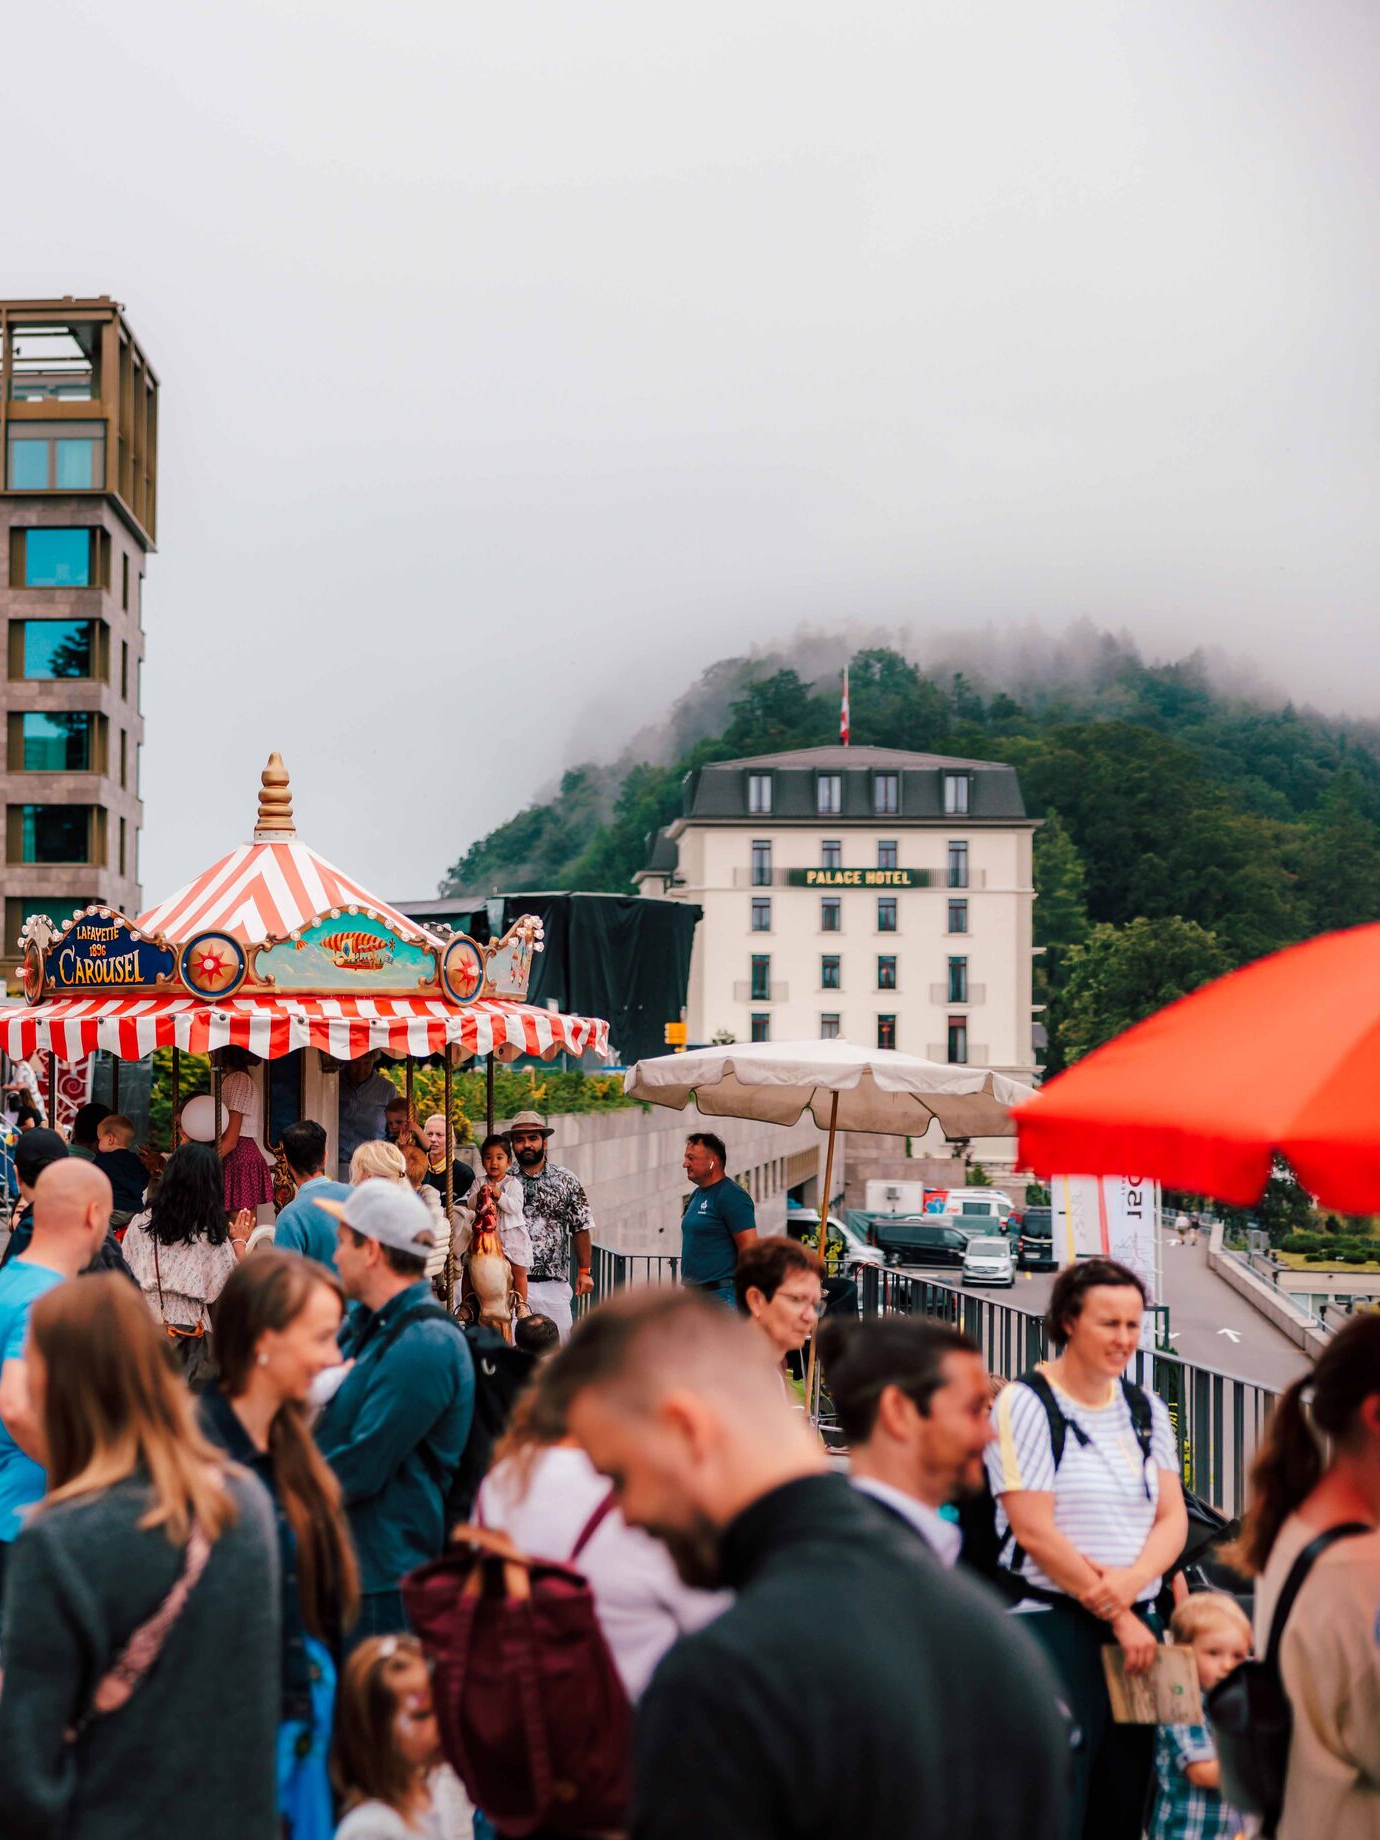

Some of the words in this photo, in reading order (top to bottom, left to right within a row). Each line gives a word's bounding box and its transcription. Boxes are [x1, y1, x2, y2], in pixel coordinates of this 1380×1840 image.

[806, 871, 862, 884] PALACE
[865, 871, 911, 884] HOTEL
[76, 926, 119, 941] LAFAYETTE
[89, 944, 106, 957] 1896
